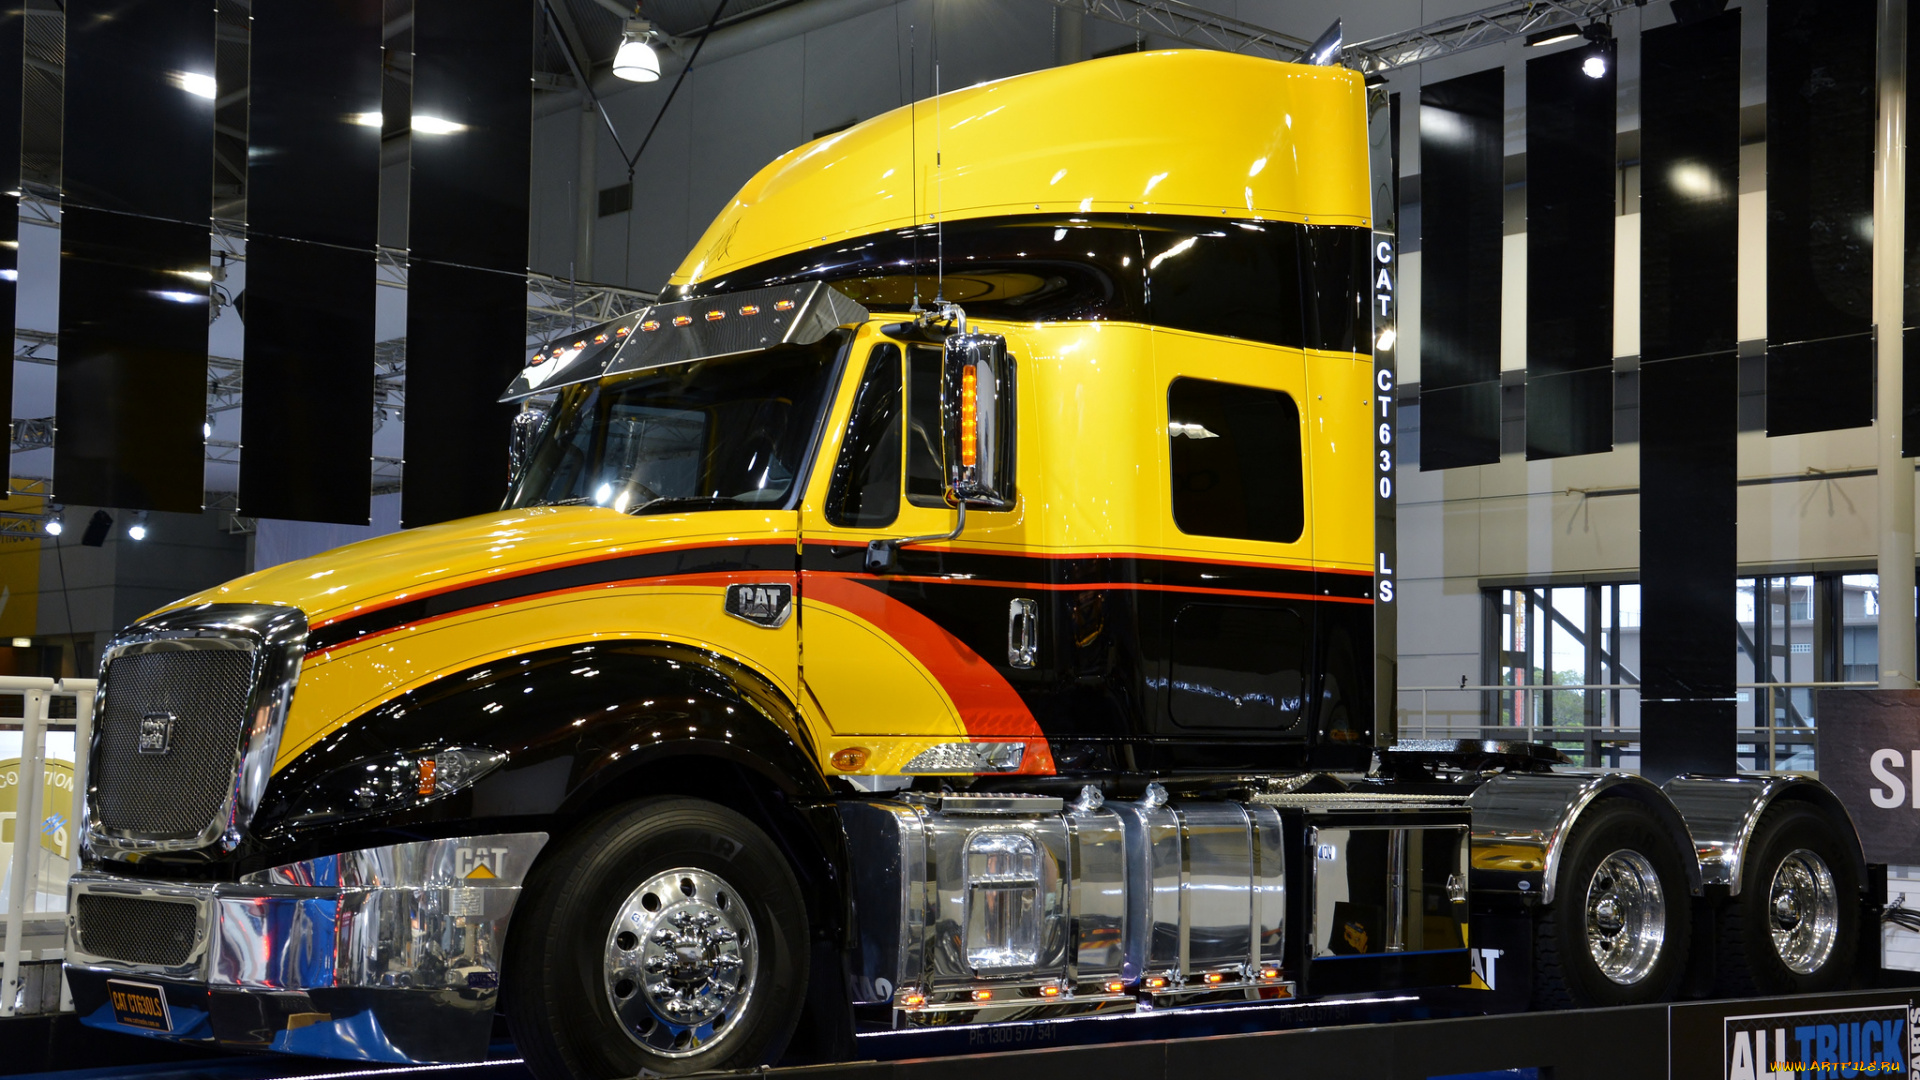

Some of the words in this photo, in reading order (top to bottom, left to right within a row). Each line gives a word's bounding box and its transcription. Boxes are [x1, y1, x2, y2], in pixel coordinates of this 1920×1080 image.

[1376, 241, 1392, 316] CAT
[1377, 369, 1392, 498] CT630
[1379, 552, 1393, 602] LS
[738, 587, 780, 617] CAT
[1869, 748, 1920, 809] S
[455, 847, 508, 879] CAT
[1471, 948, 1500, 990] AT
[112, 991, 128, 1011] CAT
[127, 994, 163, 1017] CT630LS
[988, 1027, 1012, 1044] 1300
[1015, 1026, 1035, 1042] 577
[1038, 1024, 1056, 1040] 541
